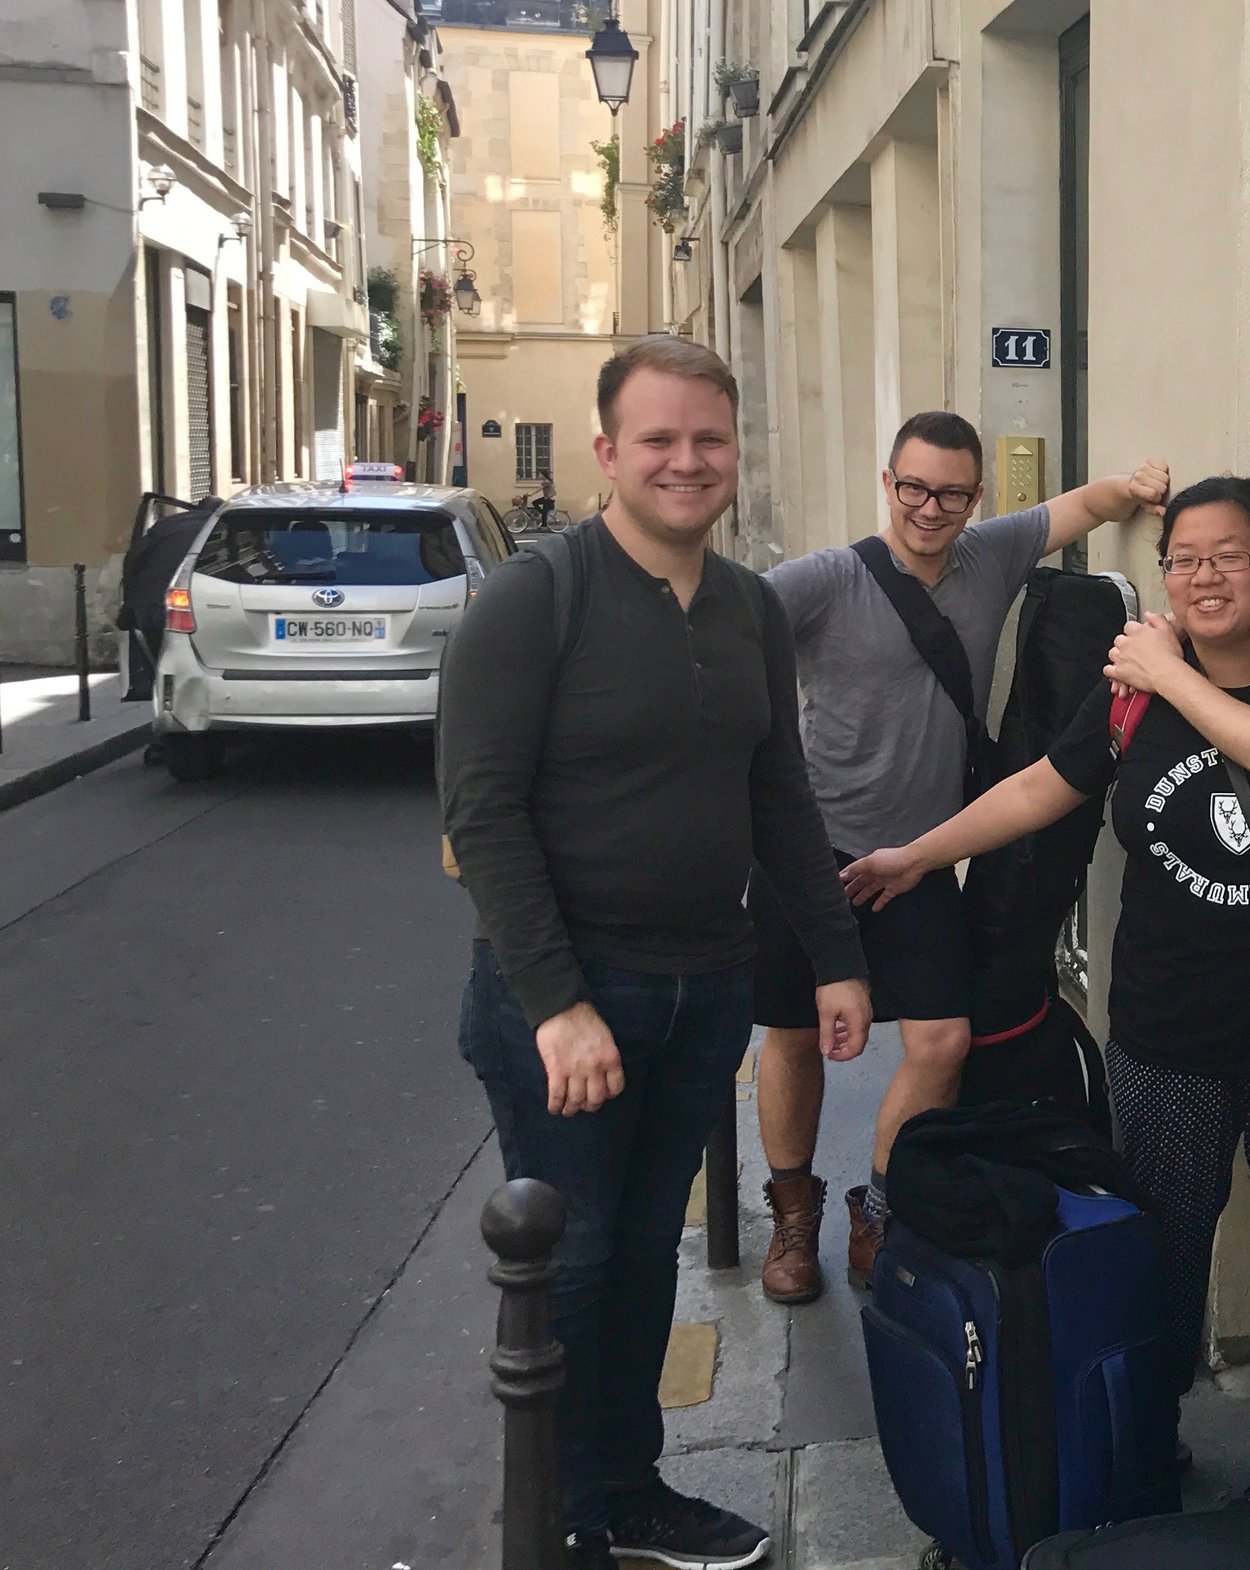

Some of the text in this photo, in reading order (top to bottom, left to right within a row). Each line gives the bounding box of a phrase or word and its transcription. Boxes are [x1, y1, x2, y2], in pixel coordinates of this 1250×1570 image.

[1004, 335, 1036, 360] 11
[360, 464, 387, 472] TAXI
[287, 621, 373, 636] CW-560-NQ
